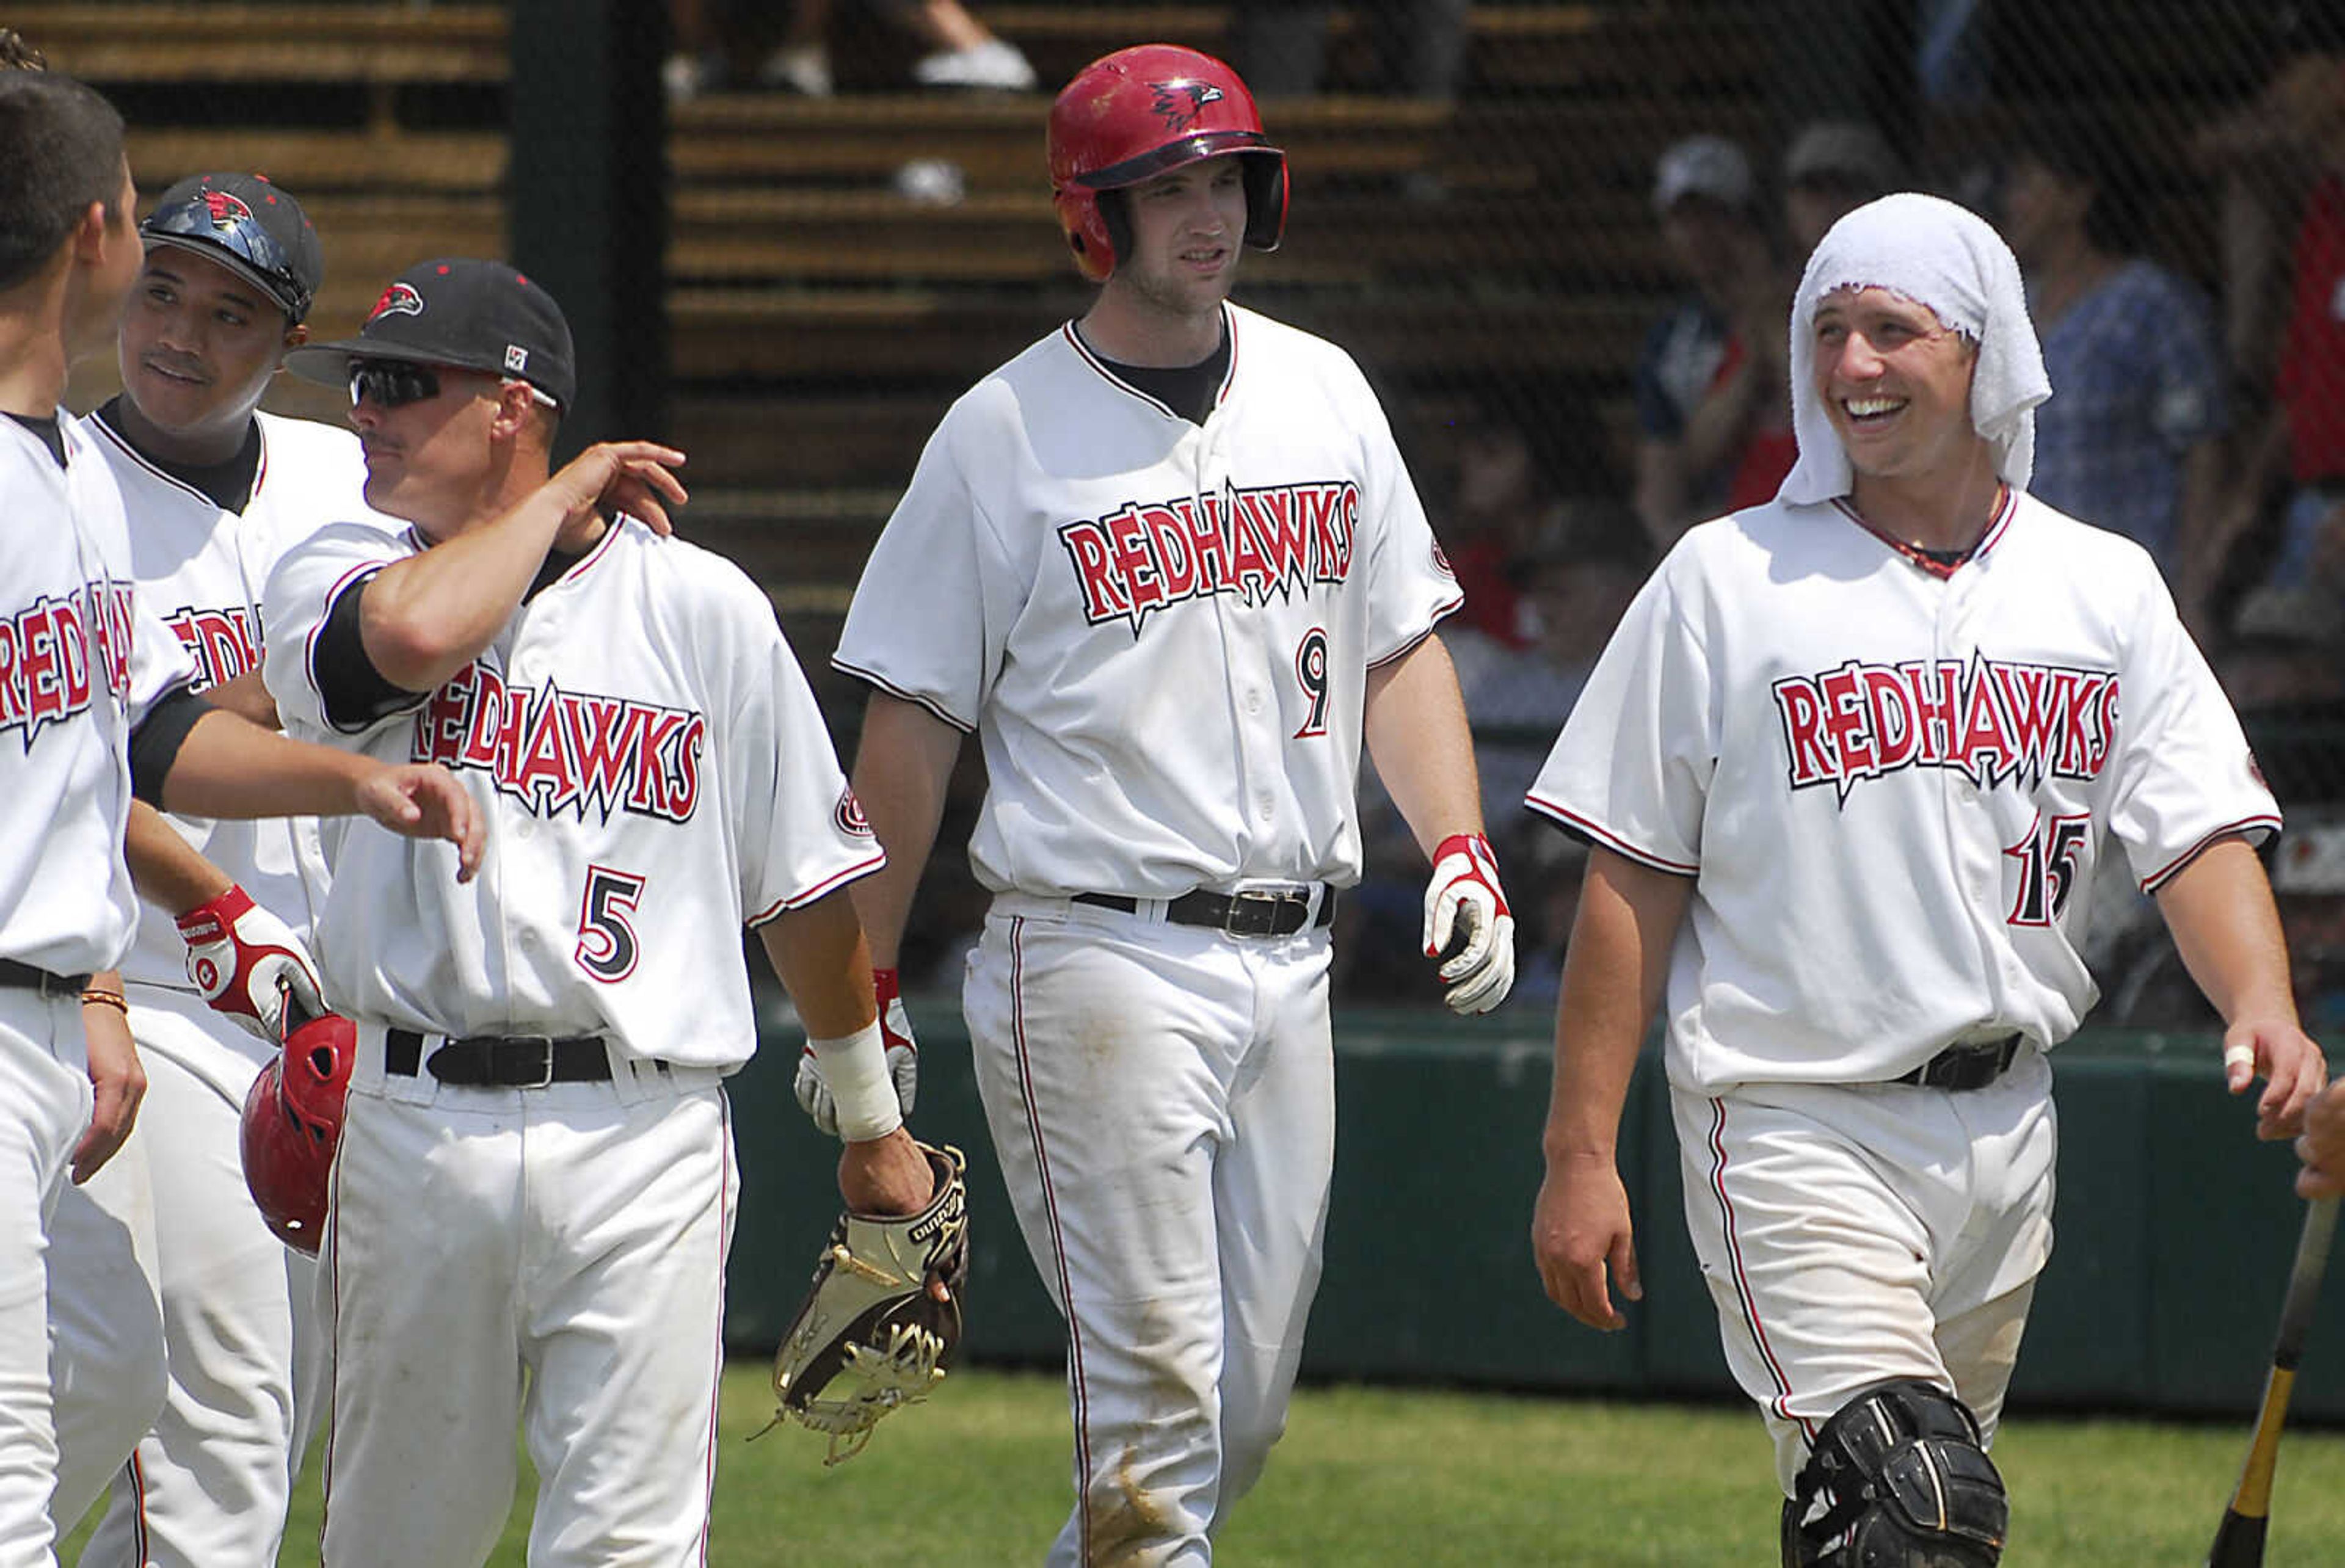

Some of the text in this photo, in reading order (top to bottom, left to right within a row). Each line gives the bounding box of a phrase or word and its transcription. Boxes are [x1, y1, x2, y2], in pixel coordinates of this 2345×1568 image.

[1057, 475, 1361, 641] REDHAWKS
[1293, 626, 1329, 739] 9
[1772, 645, 2120, 812] REDHAWKS
[575, 864, 645, 984] 5
[2003, 807, 2091, 927] 15
